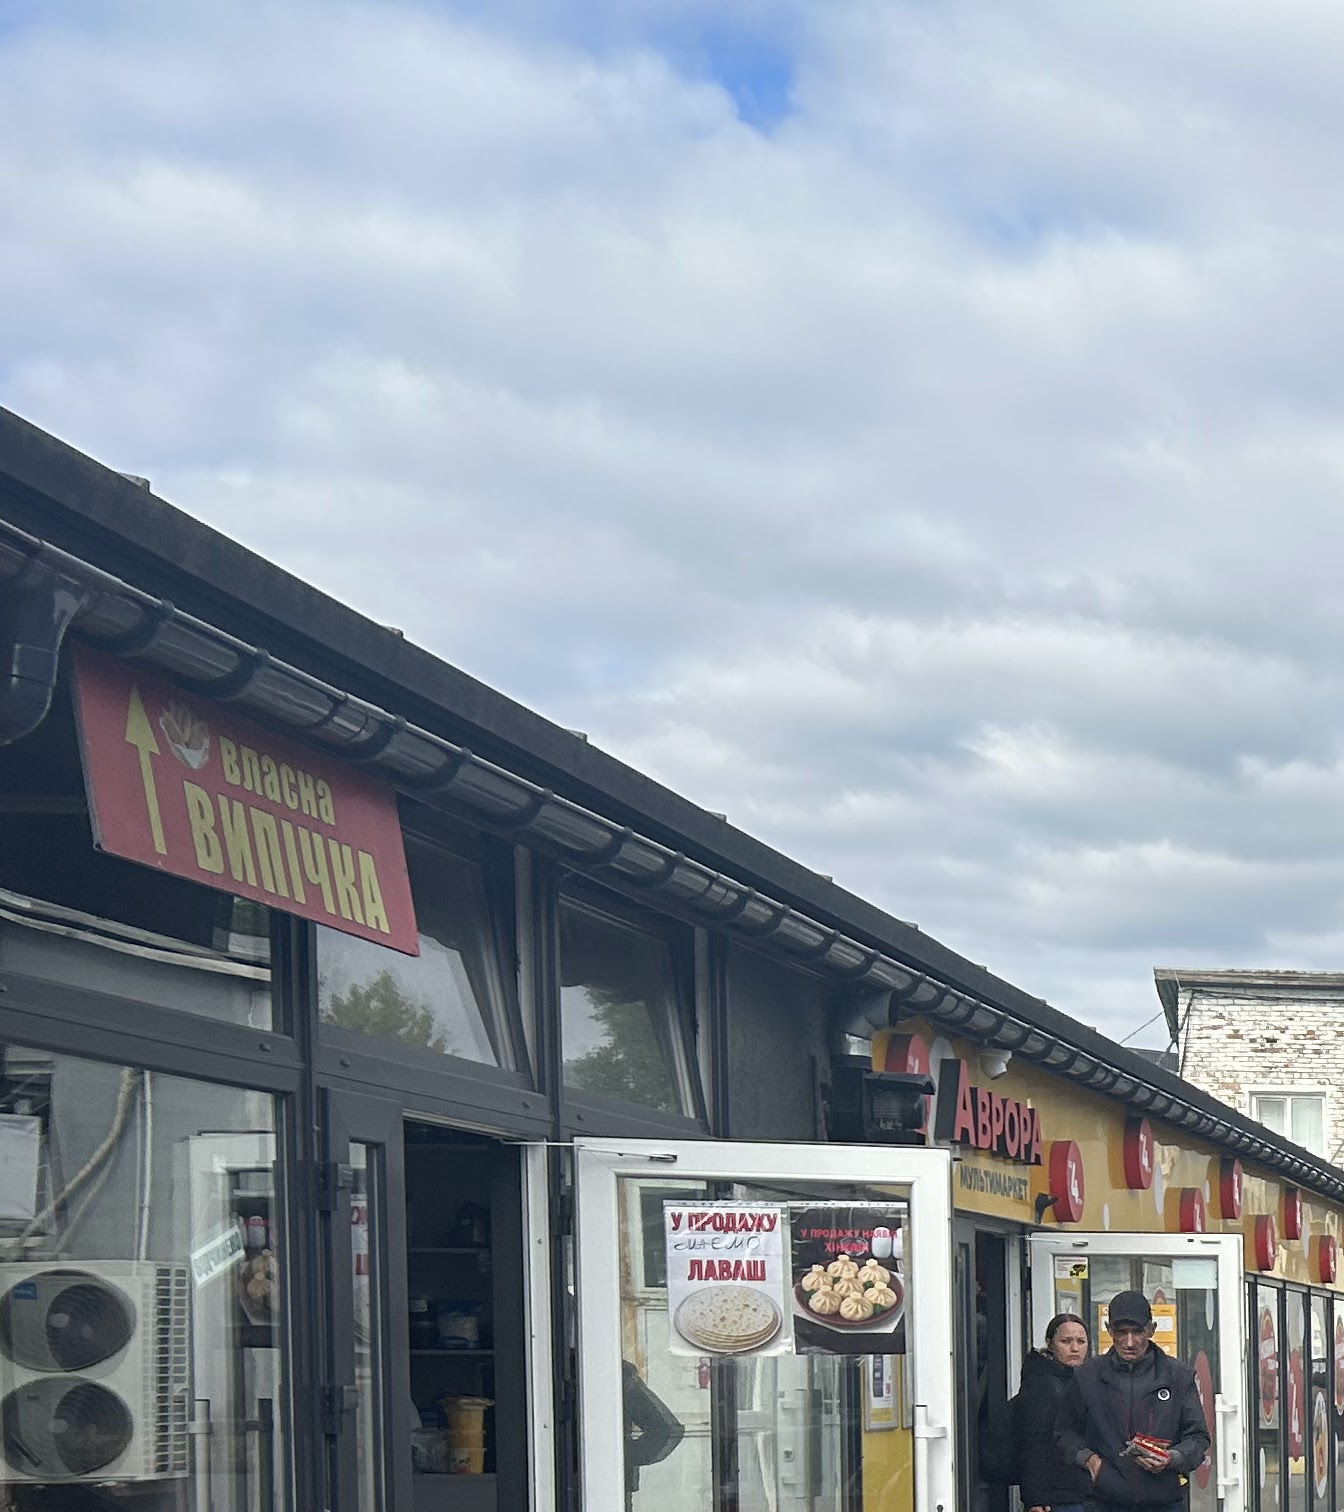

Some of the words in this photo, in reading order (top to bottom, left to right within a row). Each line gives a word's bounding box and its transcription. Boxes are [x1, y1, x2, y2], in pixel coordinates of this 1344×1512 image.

[219, 736, 337, 827] власна
[183, 779, 391, 934] ВИПІЧКА
[954, 1059, 1044, 1165] АВРОРА
[960, 1165, 1029, 1201] МУЛЬТИМАРКЕТ
[670, 1212, 683, 1232] У
[688, 1212, 778, 1234] ПРОДАЖУ
[688, 1259, 766, 1282] ЛАВАШ
